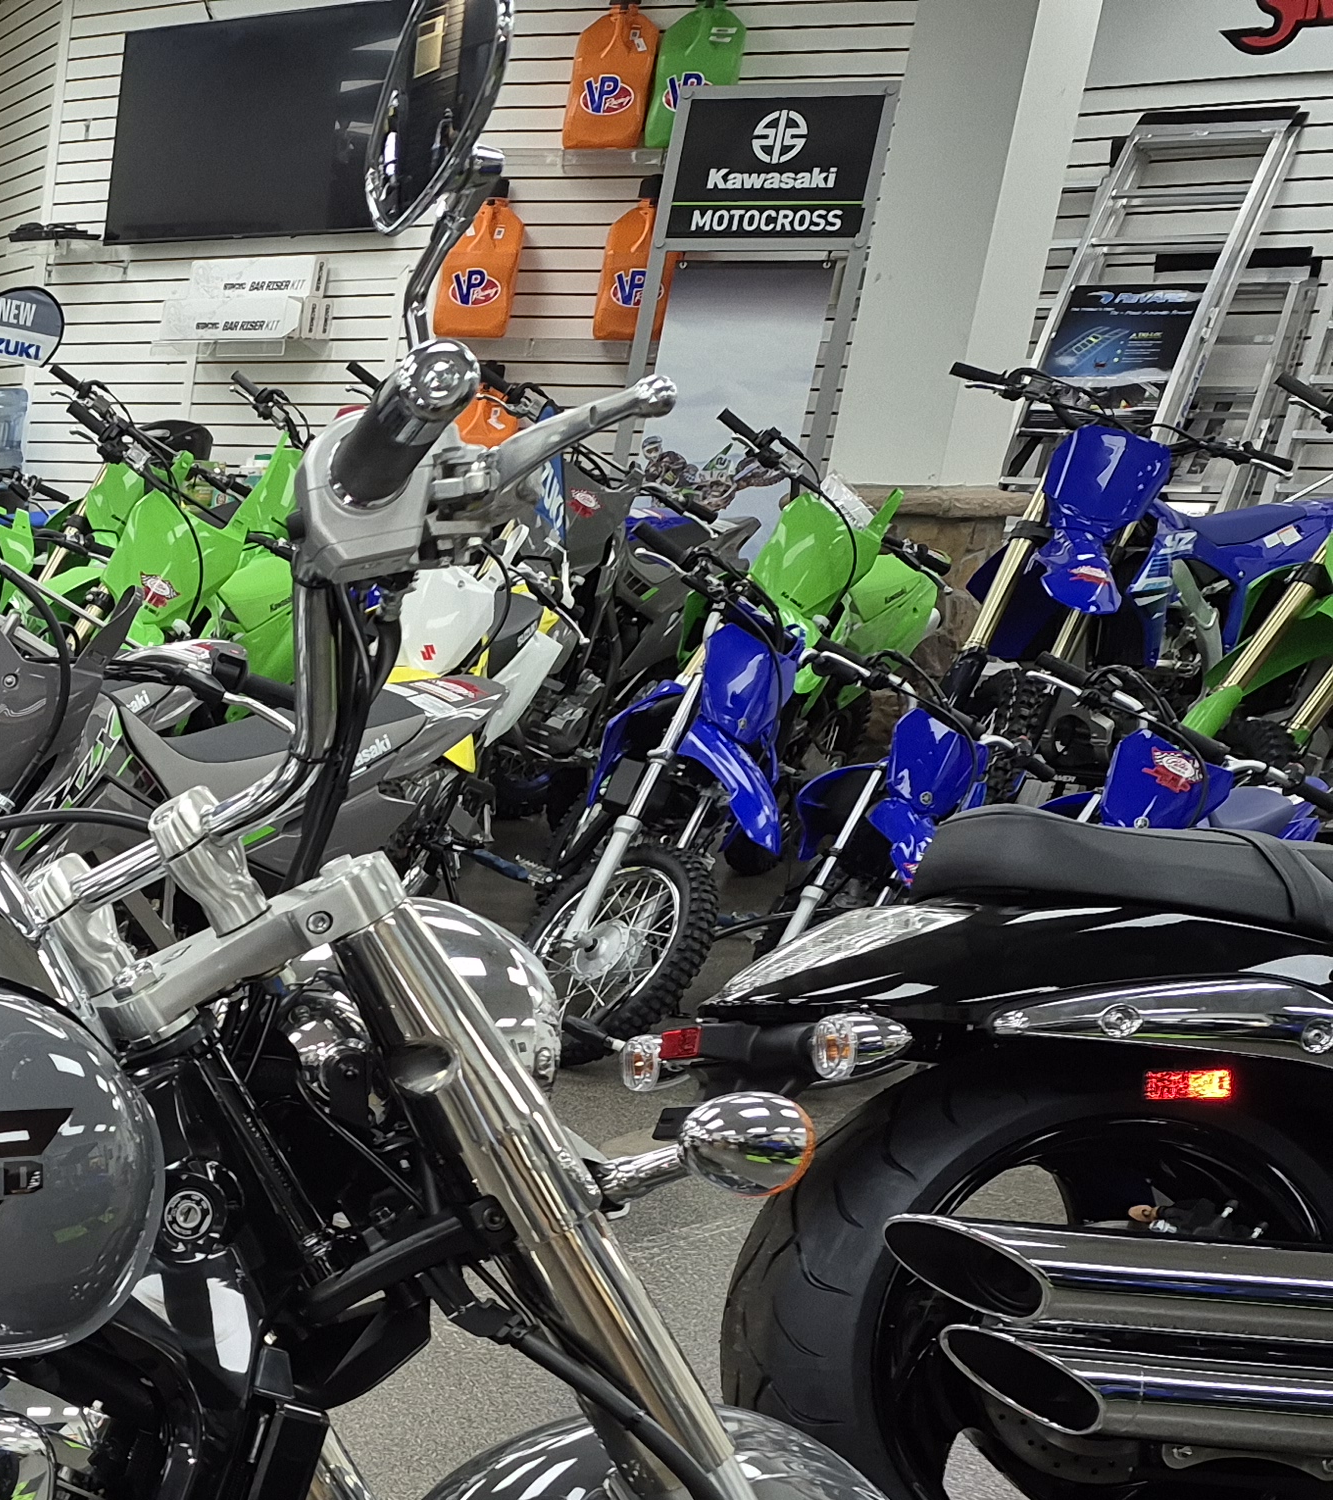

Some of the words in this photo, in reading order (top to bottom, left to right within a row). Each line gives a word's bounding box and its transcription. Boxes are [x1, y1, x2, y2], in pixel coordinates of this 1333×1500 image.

[584, 74, 621, 114] VP
[706, 167, 839, 189] Kawasaki
[689, 209, 844, 232] MOTOCROSS
[248, 281, 265, 292] BAR
[265, 280, 291, 291] RISER
[291, 279, 306, 290] KIT
[451, 268, 488, 306] VP
[222, 321, 239, 331] BAR
[239, 320, 265, 331] RISER
[265, 320, 281, 330] KIT
